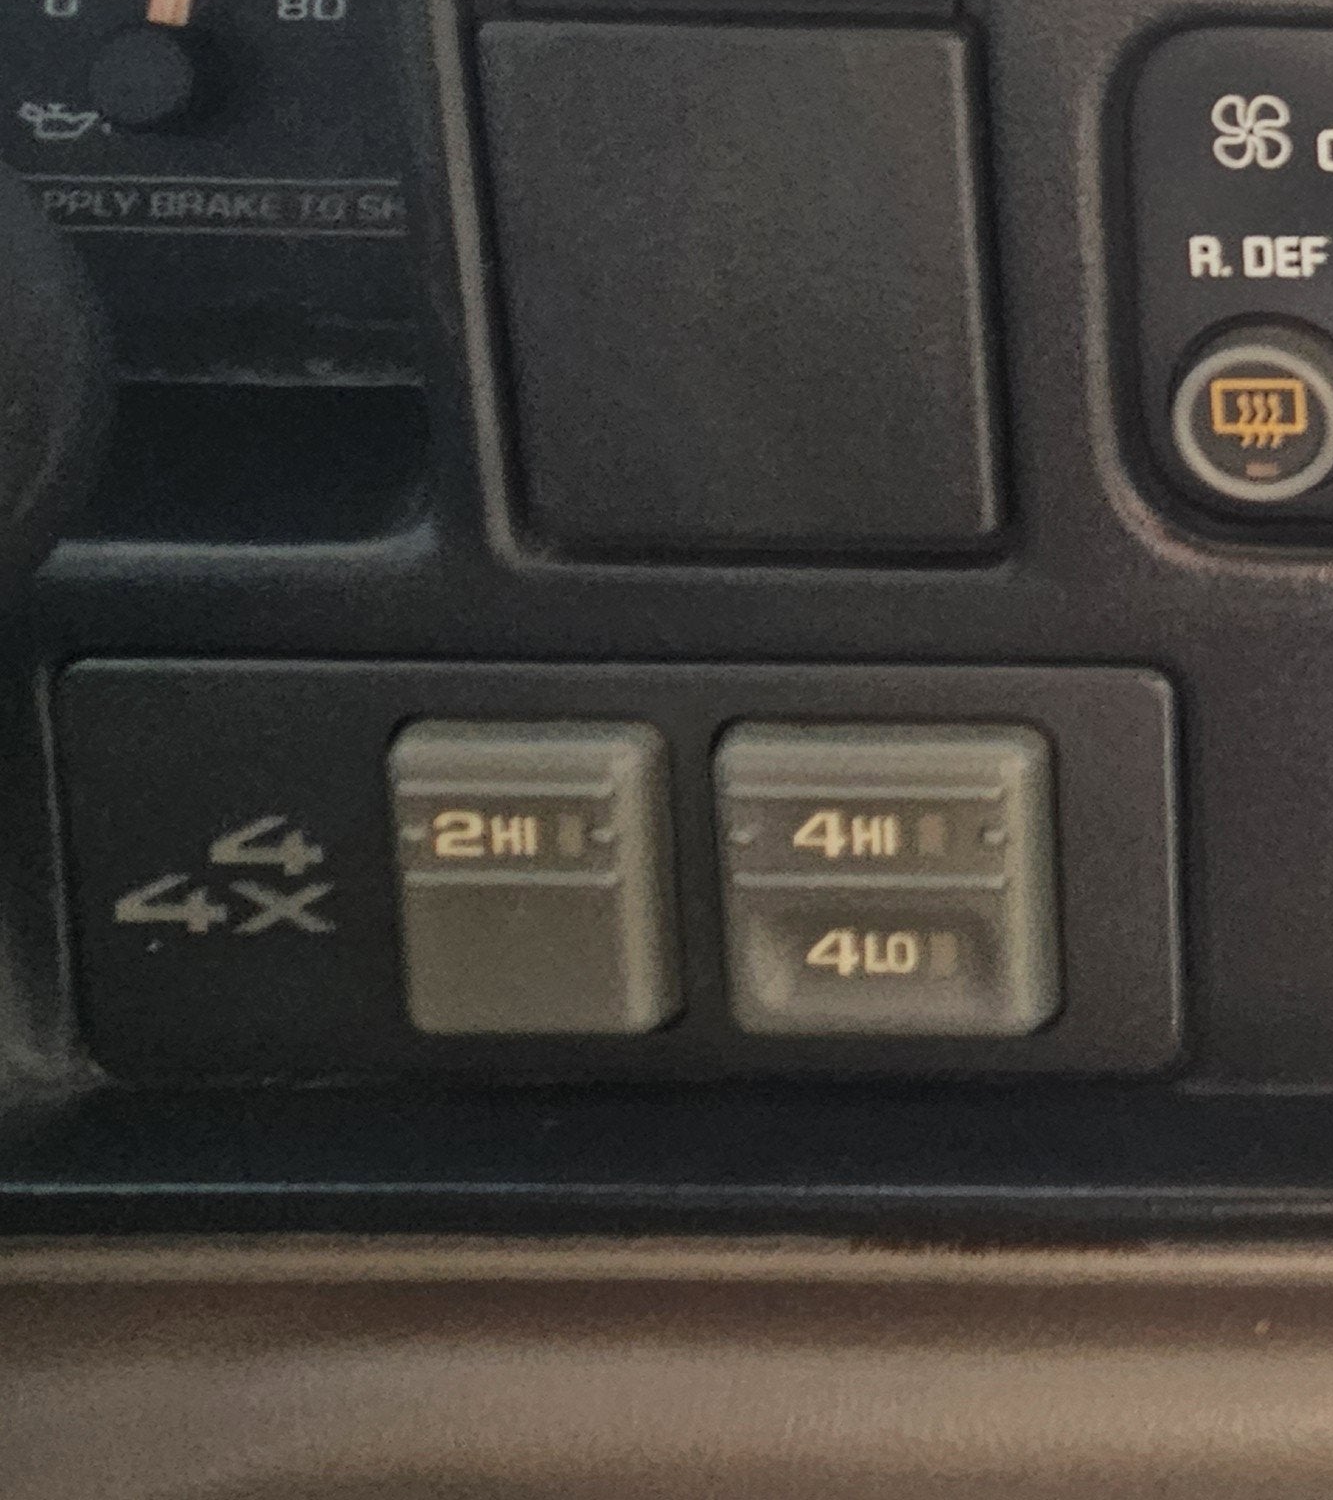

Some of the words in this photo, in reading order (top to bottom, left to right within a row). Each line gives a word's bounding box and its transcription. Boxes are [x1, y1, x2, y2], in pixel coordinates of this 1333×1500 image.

[1188, 235, 1232, 278] R.
[1242, 235, 1330, 279] DEF
[433, 810, 539, 858] 2HI
[793, 810, 899, 858] 4HI
[807, 927, 916, 976] 4LO
